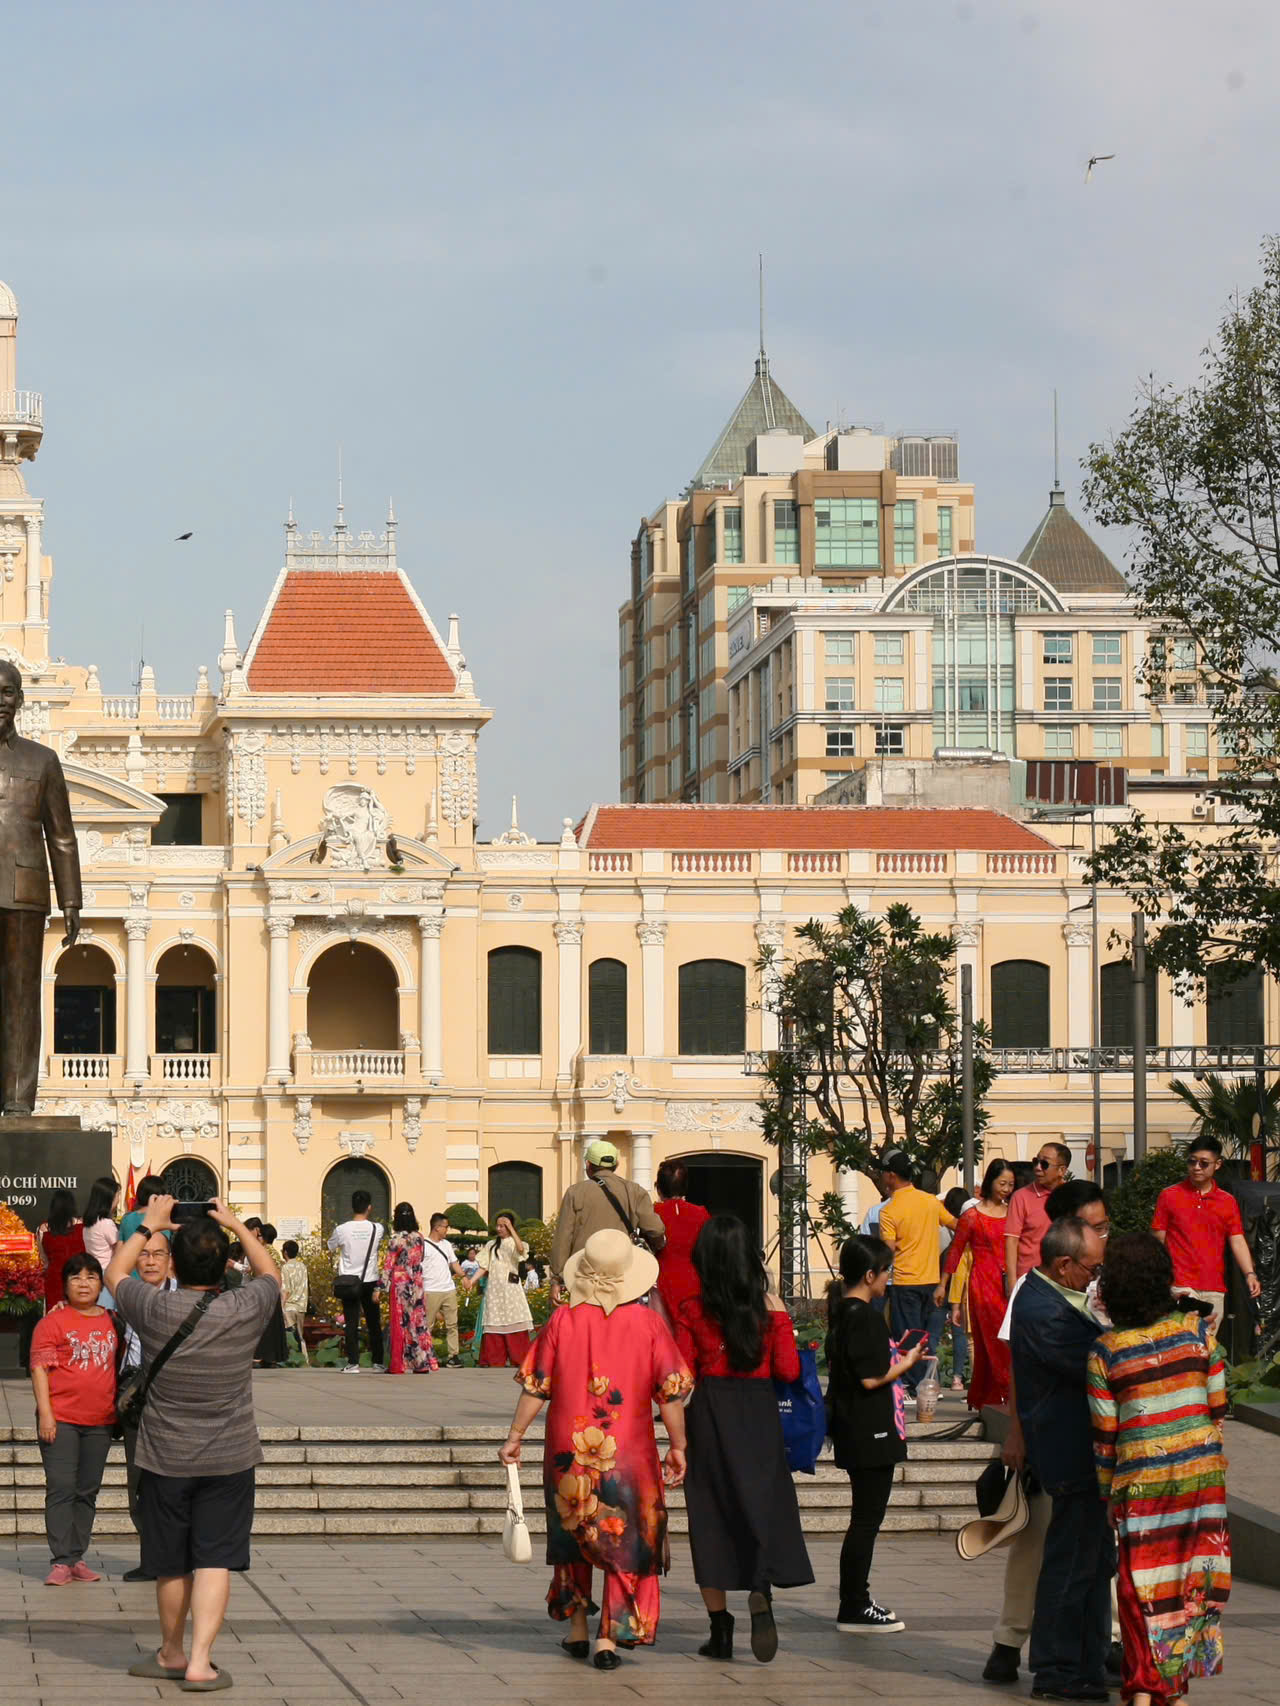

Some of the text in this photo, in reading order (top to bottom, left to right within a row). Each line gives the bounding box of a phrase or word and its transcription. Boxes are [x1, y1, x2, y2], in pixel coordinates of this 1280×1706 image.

[13, 1174, 38, 1188] CHÍ
[40, 1176, 78, 1188] MINH
[6, 1195, 37, 1207] 1969)
